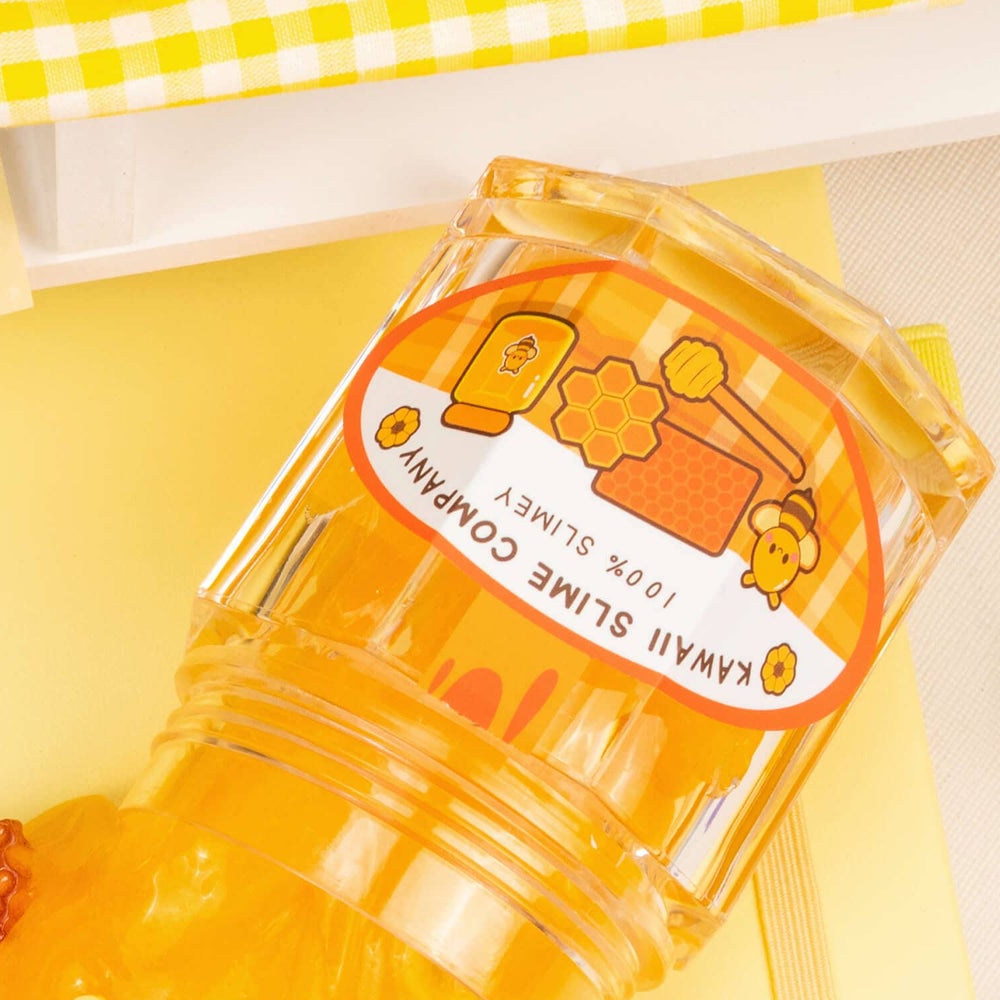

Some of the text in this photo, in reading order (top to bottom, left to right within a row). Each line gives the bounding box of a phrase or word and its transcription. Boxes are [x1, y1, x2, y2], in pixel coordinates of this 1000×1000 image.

[399, 446, 752, 686] KAWAII SLIME COMPANY
[494, 487, 676, 609] 100% SLIMEY
